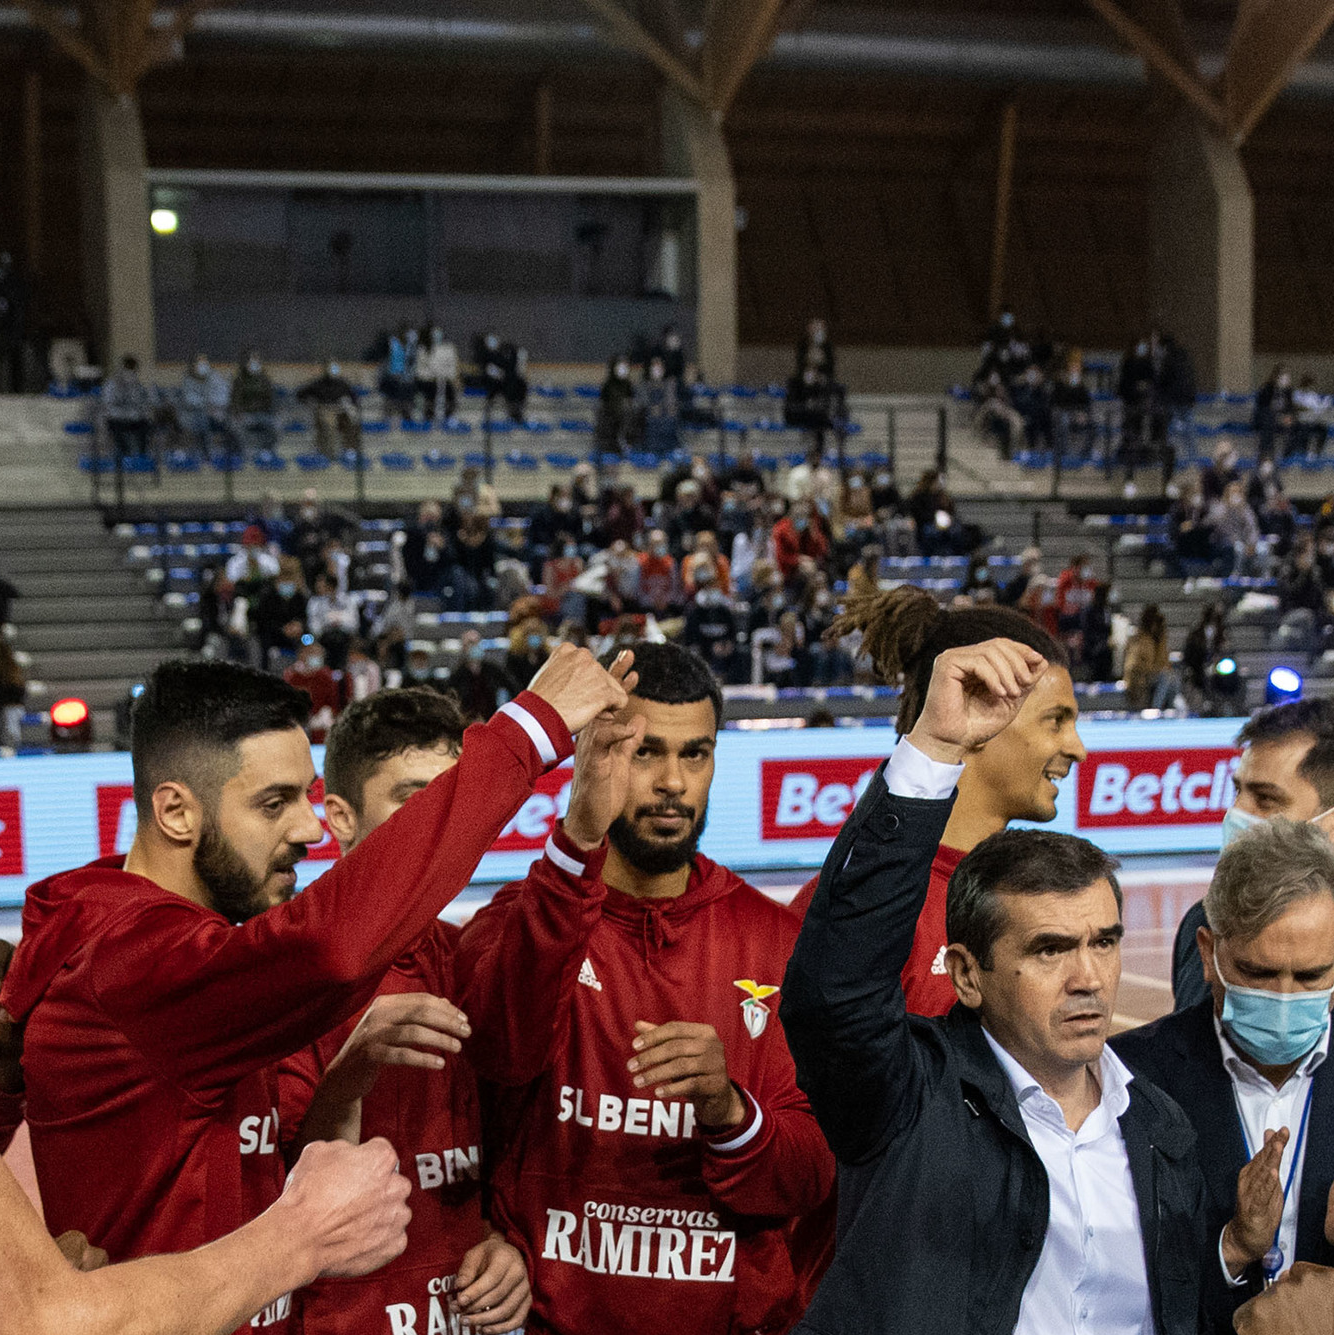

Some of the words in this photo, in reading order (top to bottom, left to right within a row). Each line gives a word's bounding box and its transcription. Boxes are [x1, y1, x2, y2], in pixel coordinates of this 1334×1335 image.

[1089, 756, 1241, 816] Betcli
[583, 1200, 720, 1228] conservas
[541, 1208, 737, 1283] RAMIREZ
